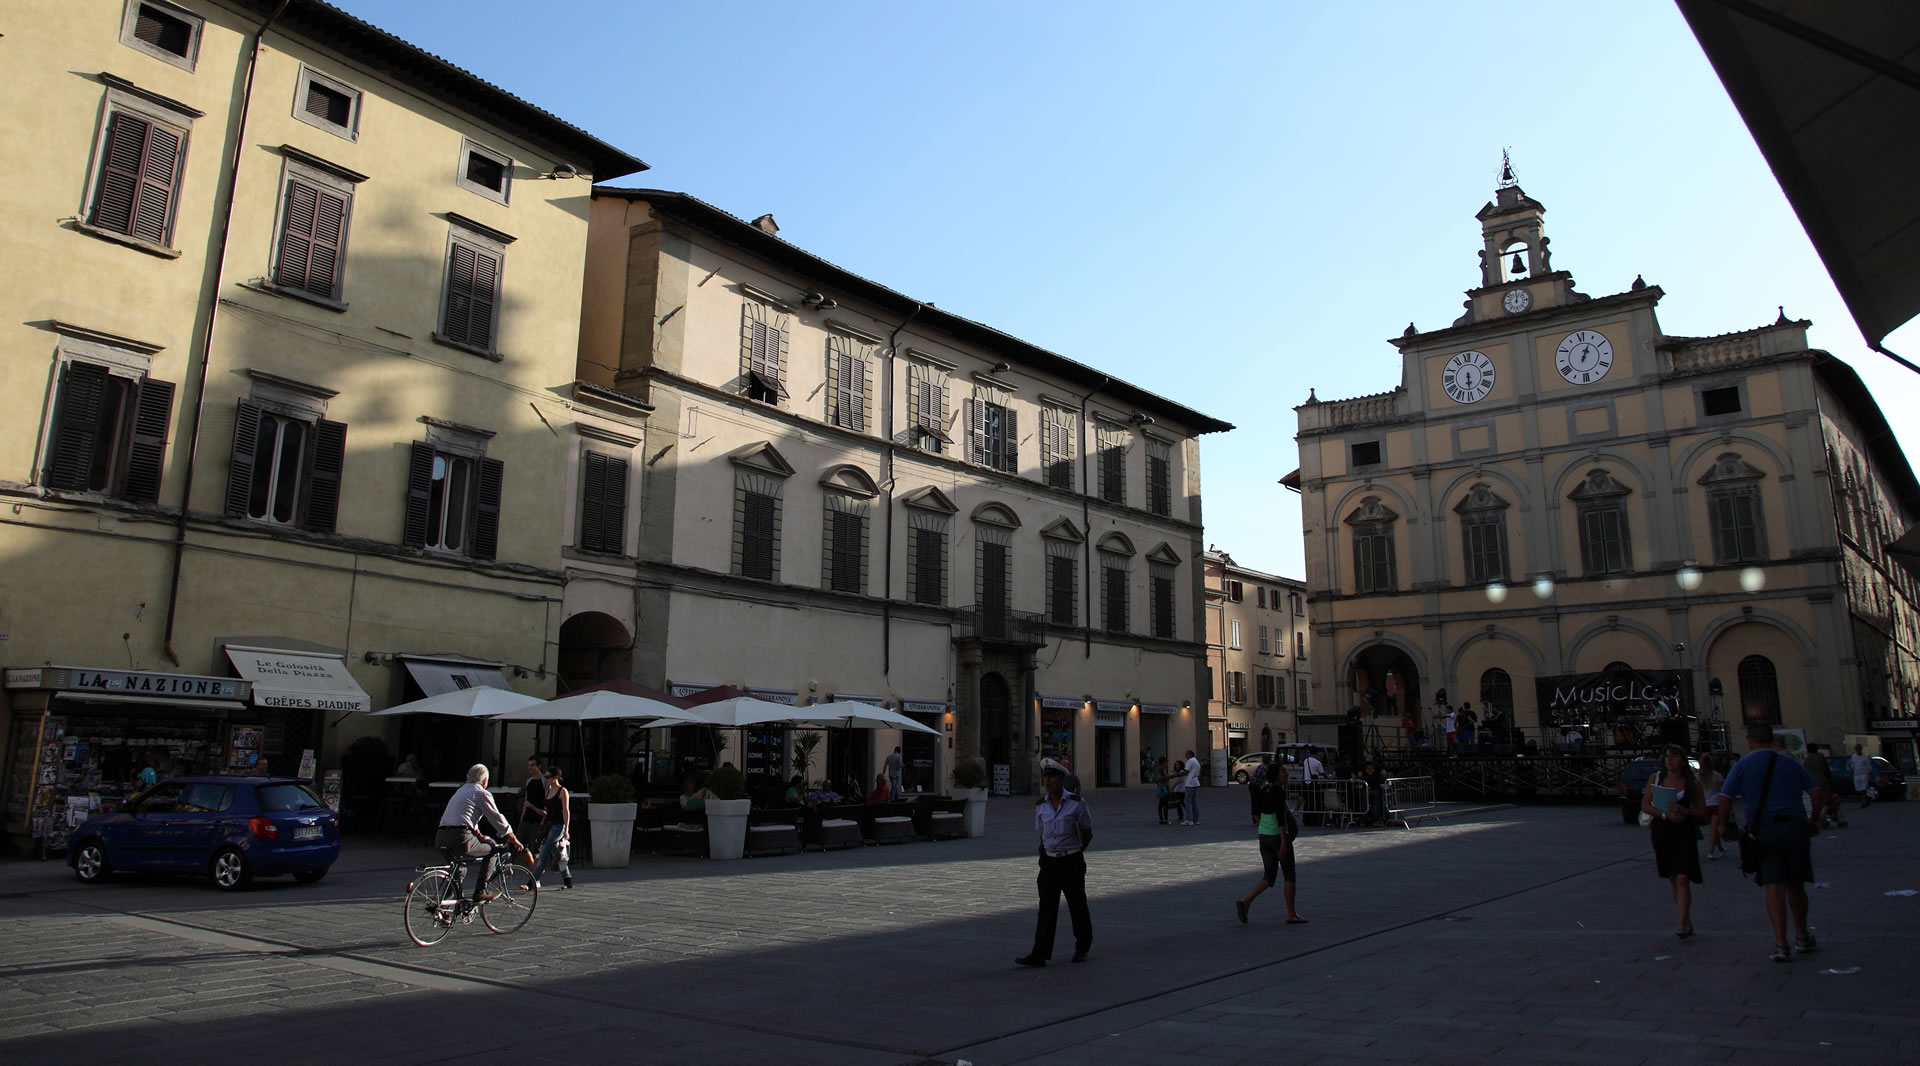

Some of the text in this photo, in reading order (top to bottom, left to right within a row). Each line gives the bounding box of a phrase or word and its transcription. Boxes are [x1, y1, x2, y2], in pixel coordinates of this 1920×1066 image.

[256, 659, 271, 667] Le
[257, 667, 333, 678] Della Piazza
[79, 673, 103, 687] LA
[126, 676, 221, 695] NAZIONE
[265, 696, 361, 711] CRÊPES PIADINE
